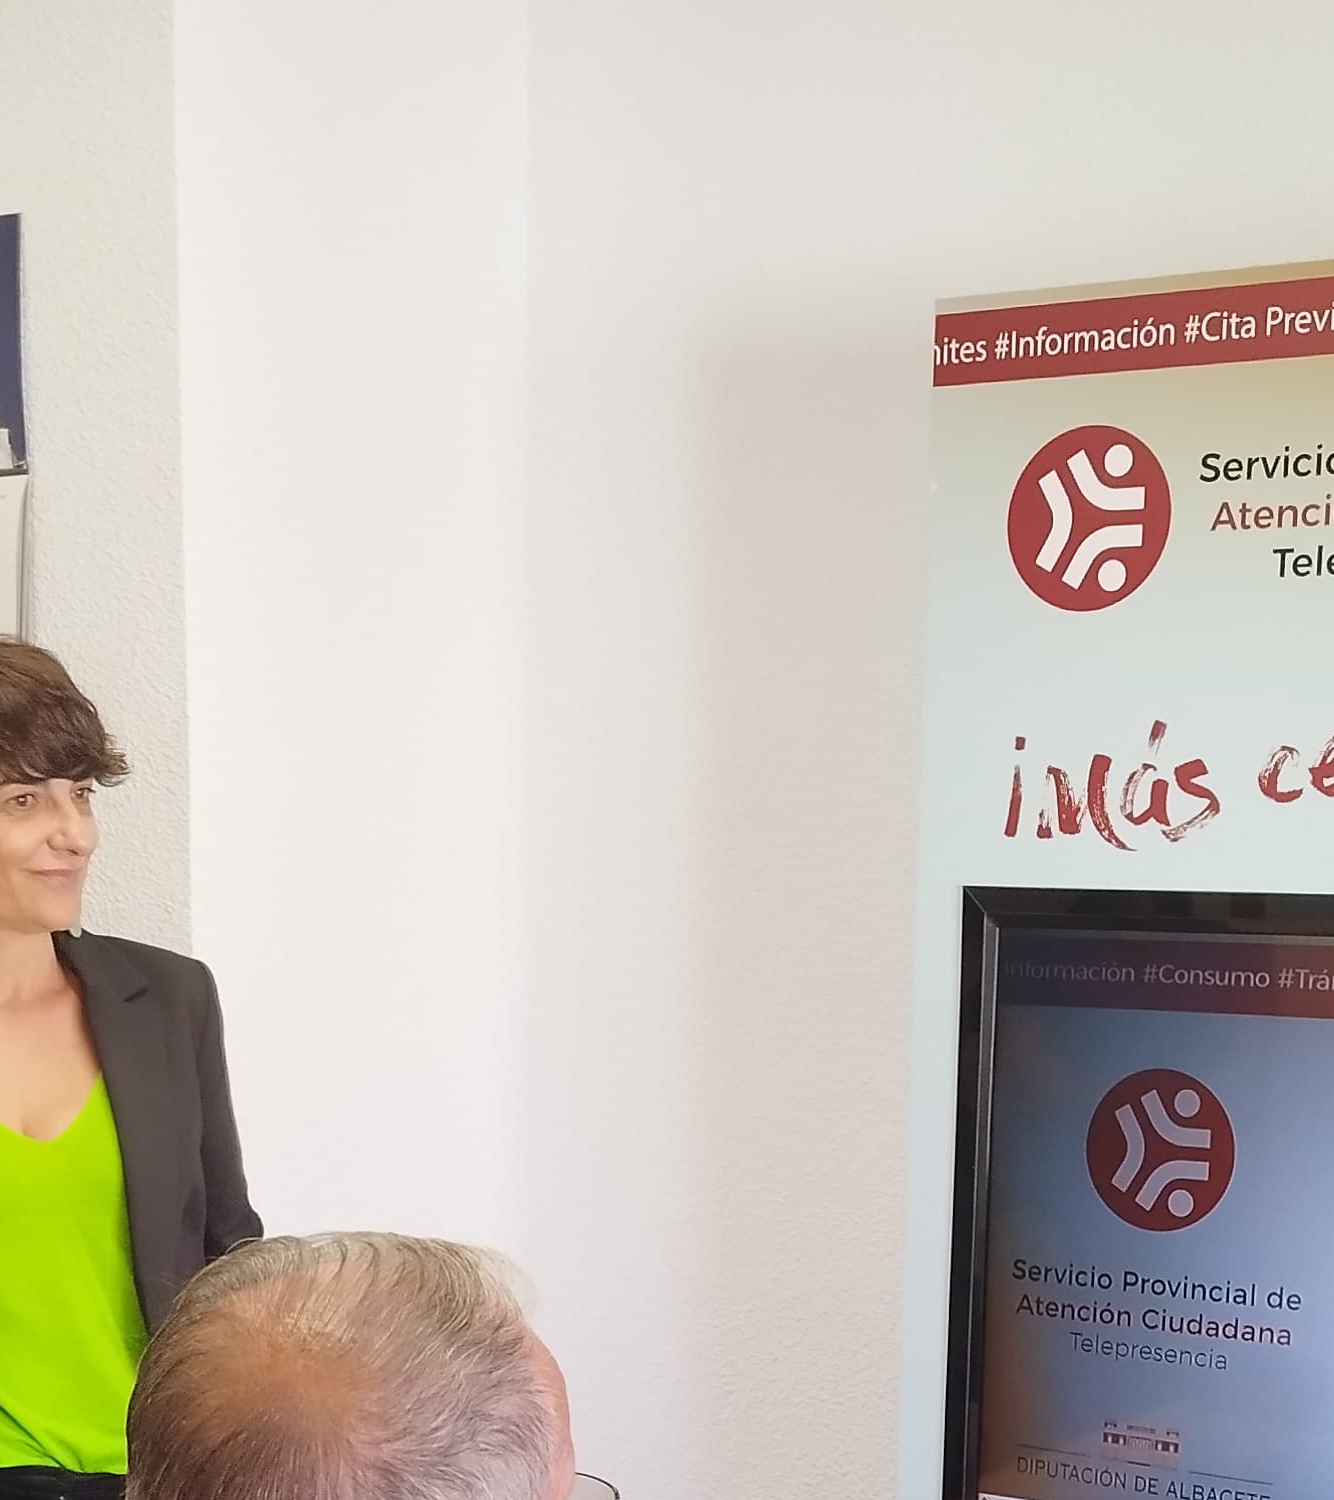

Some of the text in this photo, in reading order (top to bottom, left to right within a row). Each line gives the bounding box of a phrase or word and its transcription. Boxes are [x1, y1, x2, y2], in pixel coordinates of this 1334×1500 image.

[994, 319, 1175, 360] #Información
[1183, 306, 1257, 345] #Cita
[1003, 720, 1221, 852] ¡Más
[1143, 963, 1271, 990] #Consumo
[1011, 1259, 1303, 1312] Servicio Provincial de
[1016, 1294, 1293, 1347] Atención Ciudadana
[1070, 1332, 1228, 1370] Telepresencia
[1017, 1456, 1127, 1490] DIPUTACIÓN
[1134, 1476, 1160, 1496] DE
